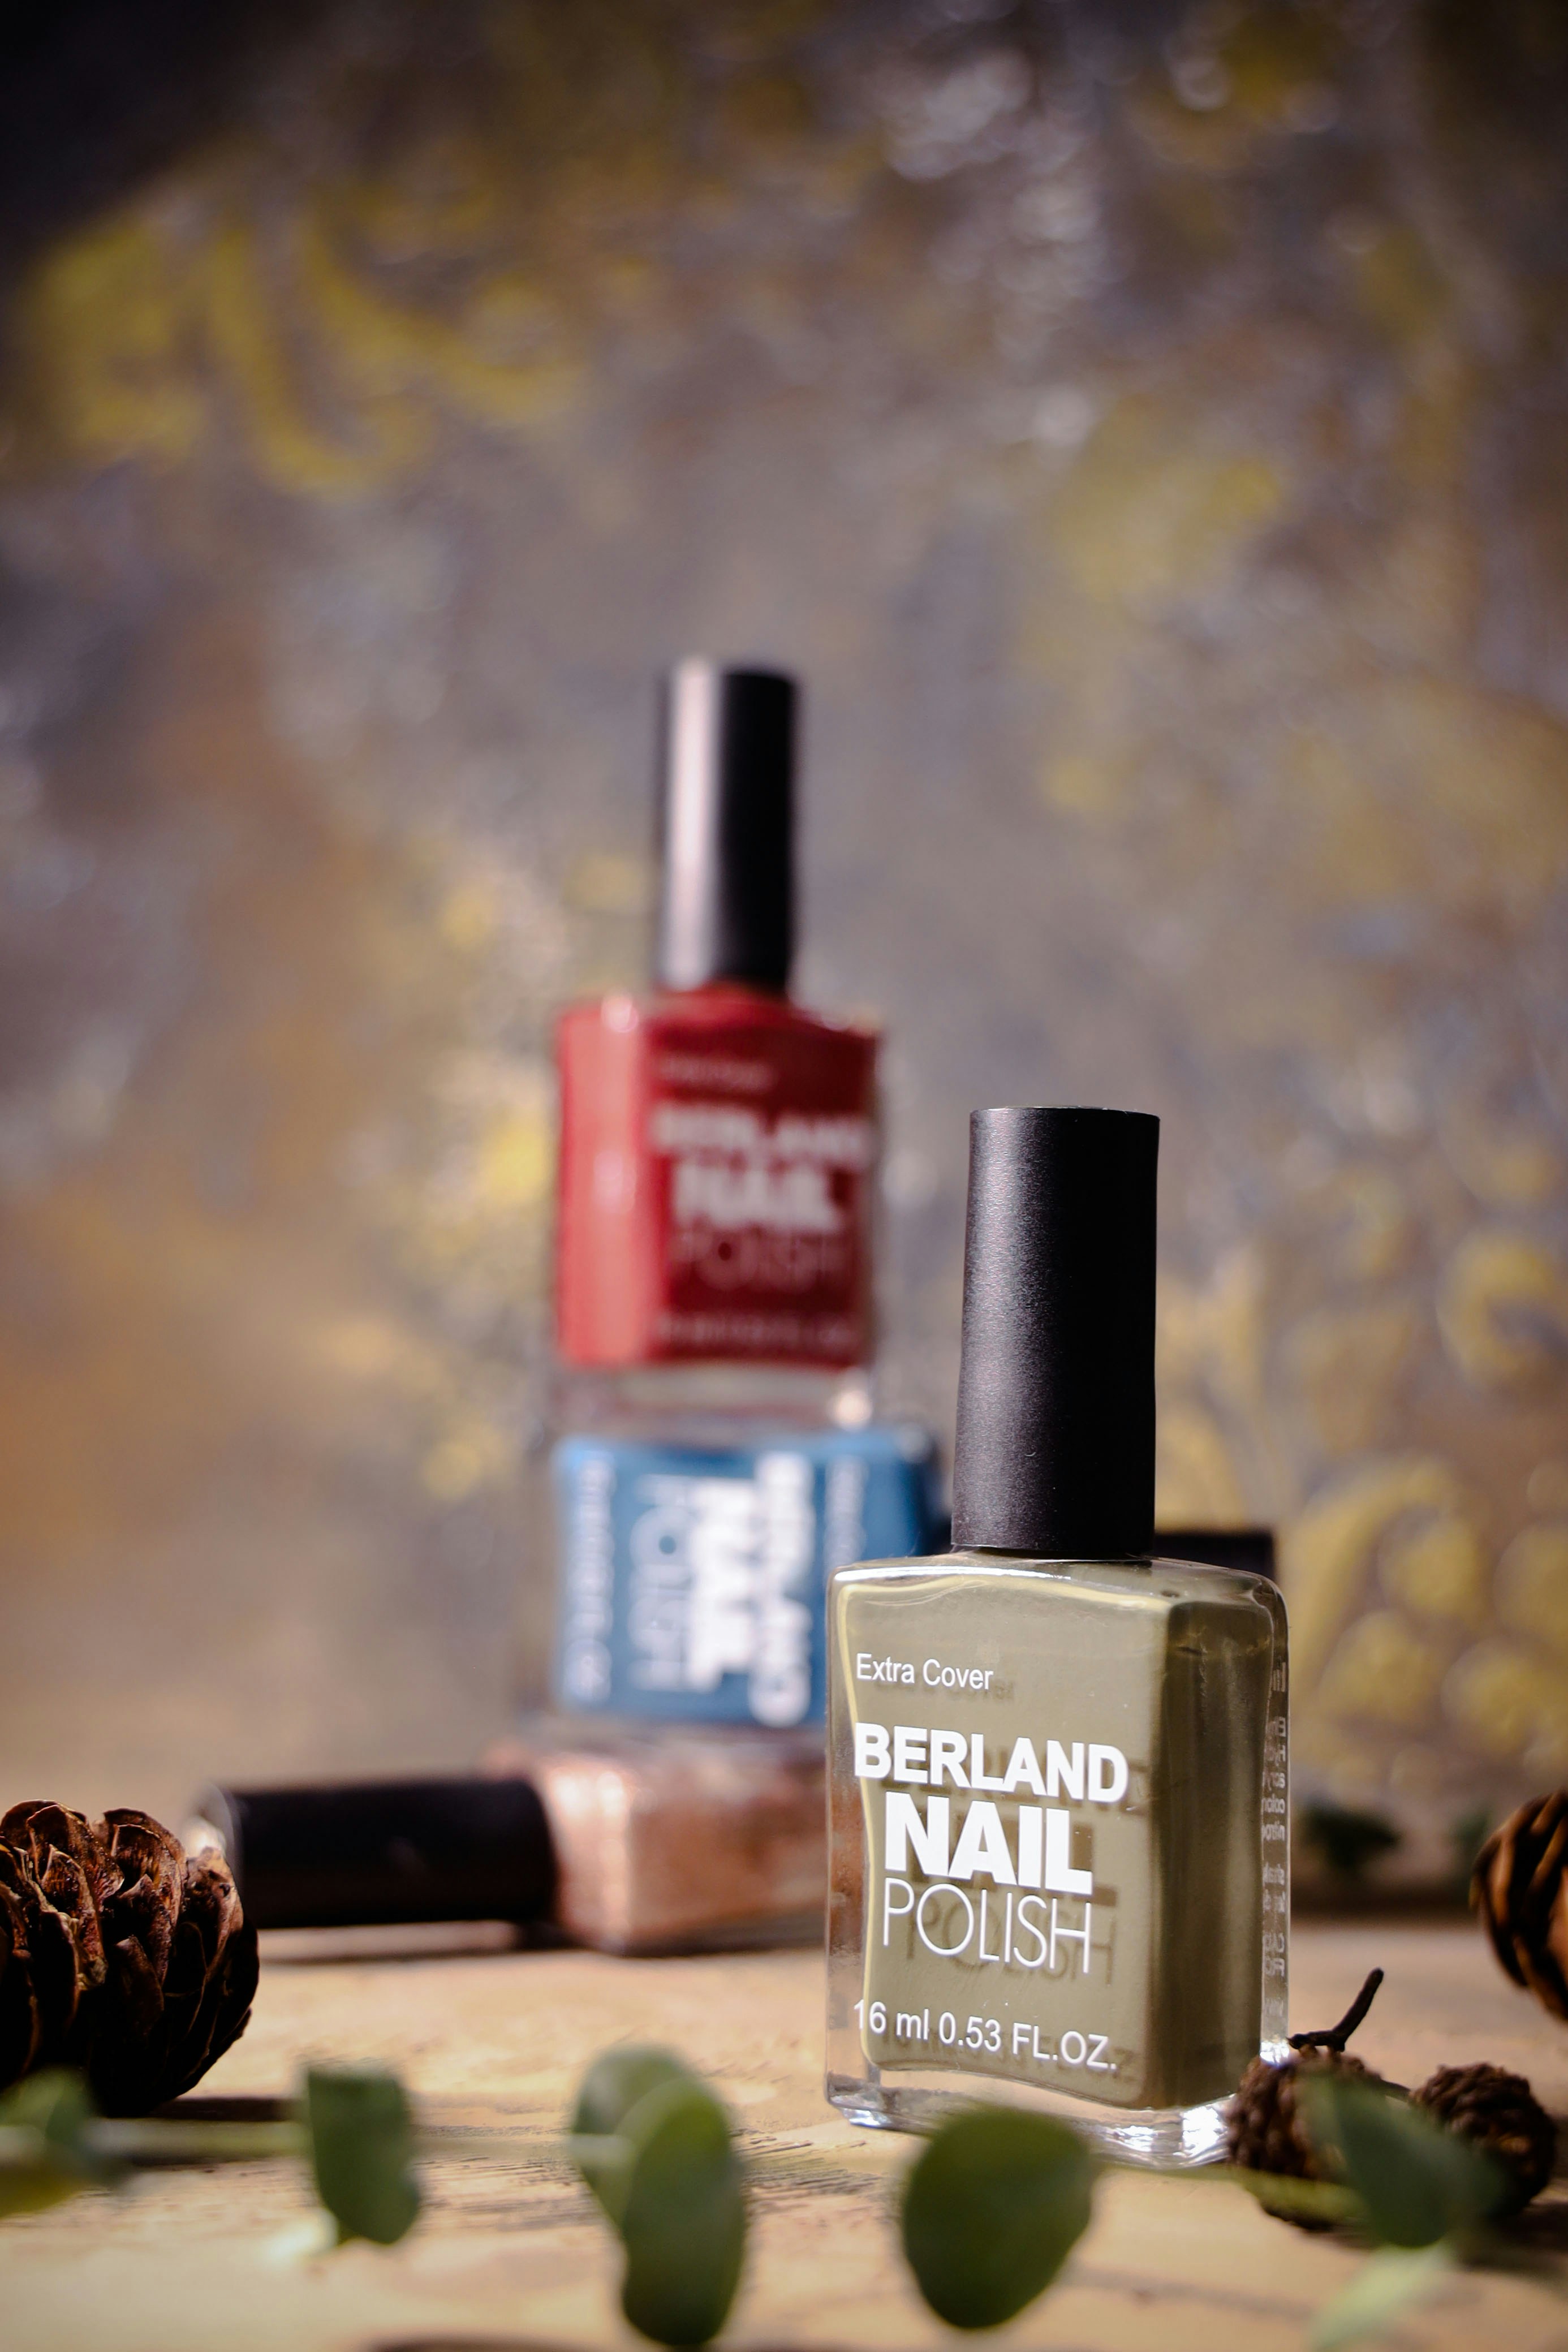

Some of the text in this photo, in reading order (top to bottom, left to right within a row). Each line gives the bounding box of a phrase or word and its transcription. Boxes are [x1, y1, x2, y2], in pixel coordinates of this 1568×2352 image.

[856, 1652, 994, 1690] Extra Cover
[854, 1722, 1128, 1803] BERLAND
[884, 1791, 1092, 1895] NAIL
[883, 1877, 1092, 1974] POLISH
[854, 1999, 1118, 2070] 16 ml 0.53 FL.OZ.
